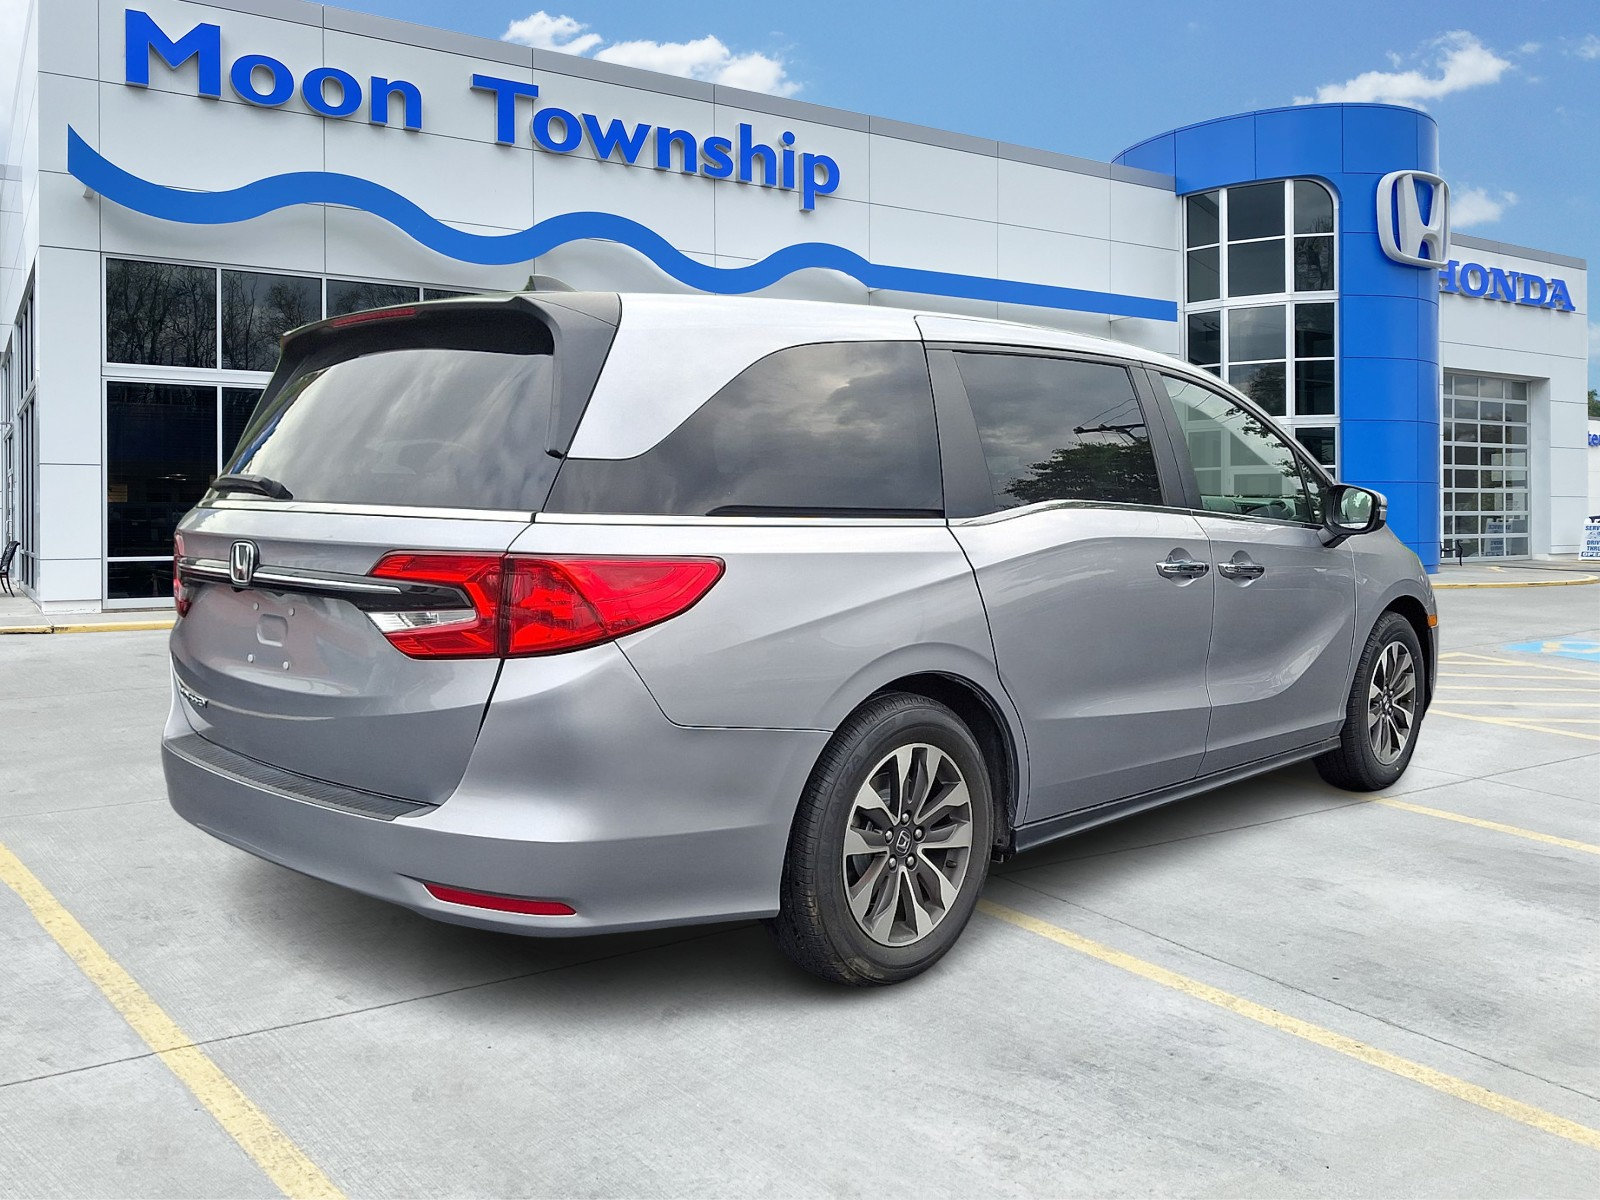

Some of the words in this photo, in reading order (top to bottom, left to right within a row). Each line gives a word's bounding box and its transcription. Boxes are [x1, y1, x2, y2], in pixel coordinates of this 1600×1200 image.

[125, 9, 422, 131] Moon
[471, 73, 841, 211] Township
[1439, 259, 1576, 312] HONDA
